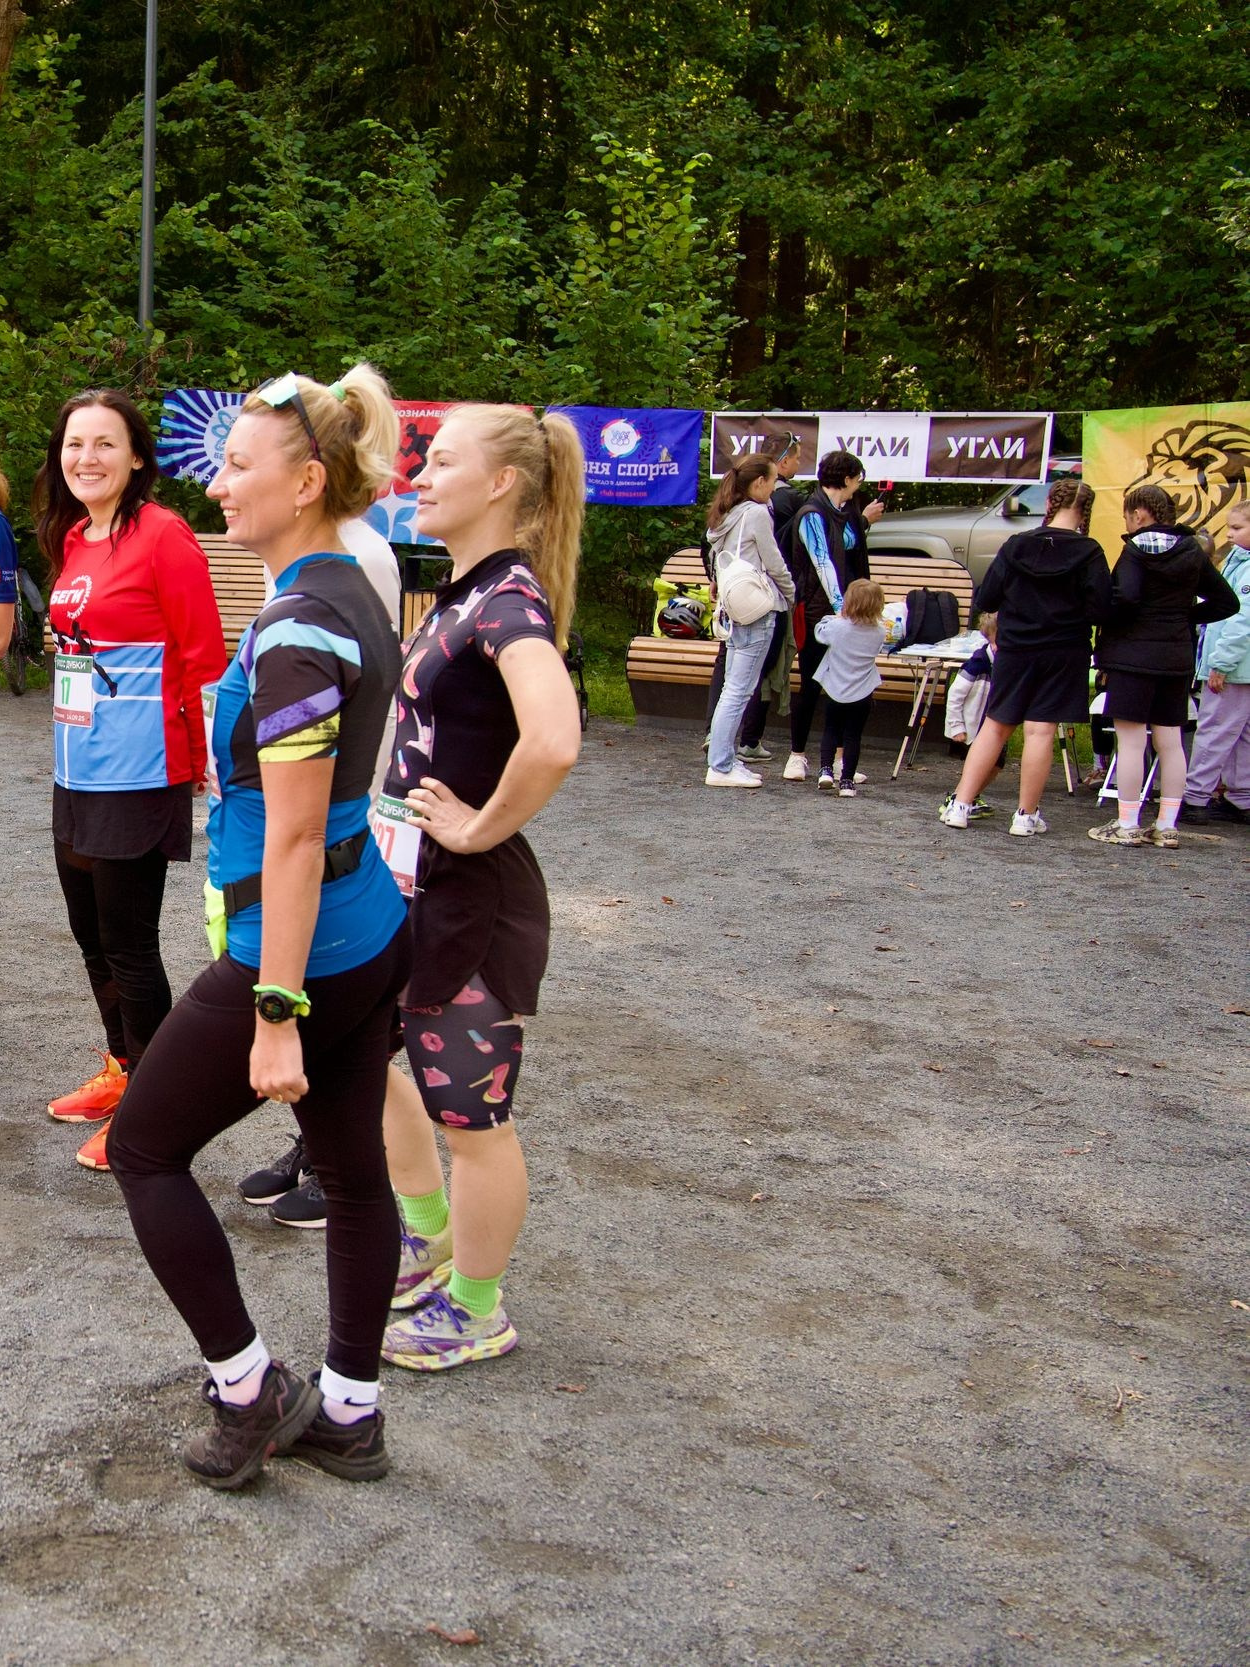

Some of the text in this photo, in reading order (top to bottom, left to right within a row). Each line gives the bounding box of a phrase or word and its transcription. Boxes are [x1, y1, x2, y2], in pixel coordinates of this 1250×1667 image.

[836, 436, 910, 457] УГЛИ
[947, 437, 1025, 460] УГЛИ
[617, 462, 679, 481] спорта
[50, 588, 85, 605] БЕГИ
[61, 676, 71, 705] 17
